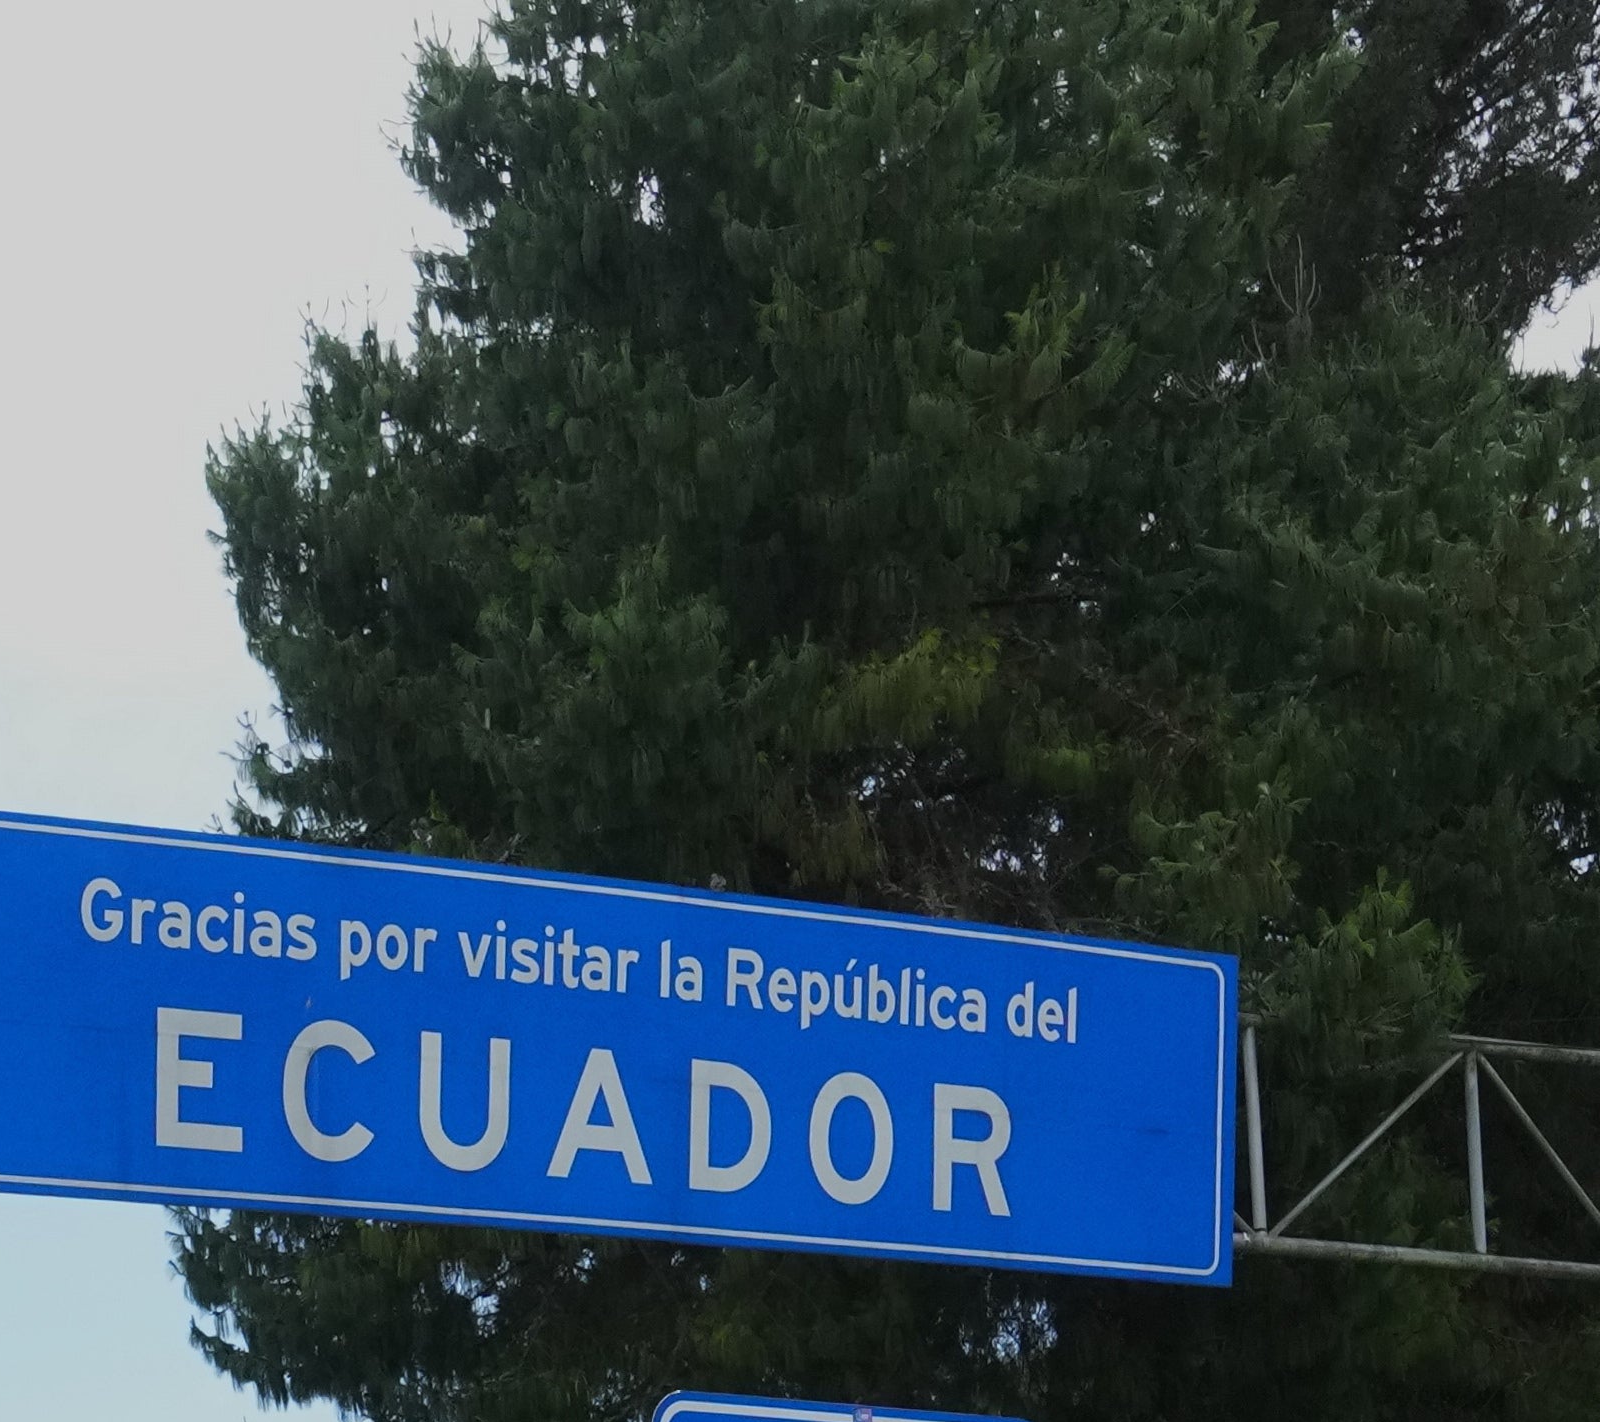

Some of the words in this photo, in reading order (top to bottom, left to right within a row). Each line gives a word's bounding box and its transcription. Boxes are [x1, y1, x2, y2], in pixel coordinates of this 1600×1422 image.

[80, 877, 318, 962] Gracias
[339, 919, 438, 982] por
[458, 919, 640, 993] visitar
[659, 939, 703, 1002] la
[726, 946, 987, 1034] República
[1006, 980, 1079, 1044] del
[155, 1006, 1012, 1218] ECUADOR
